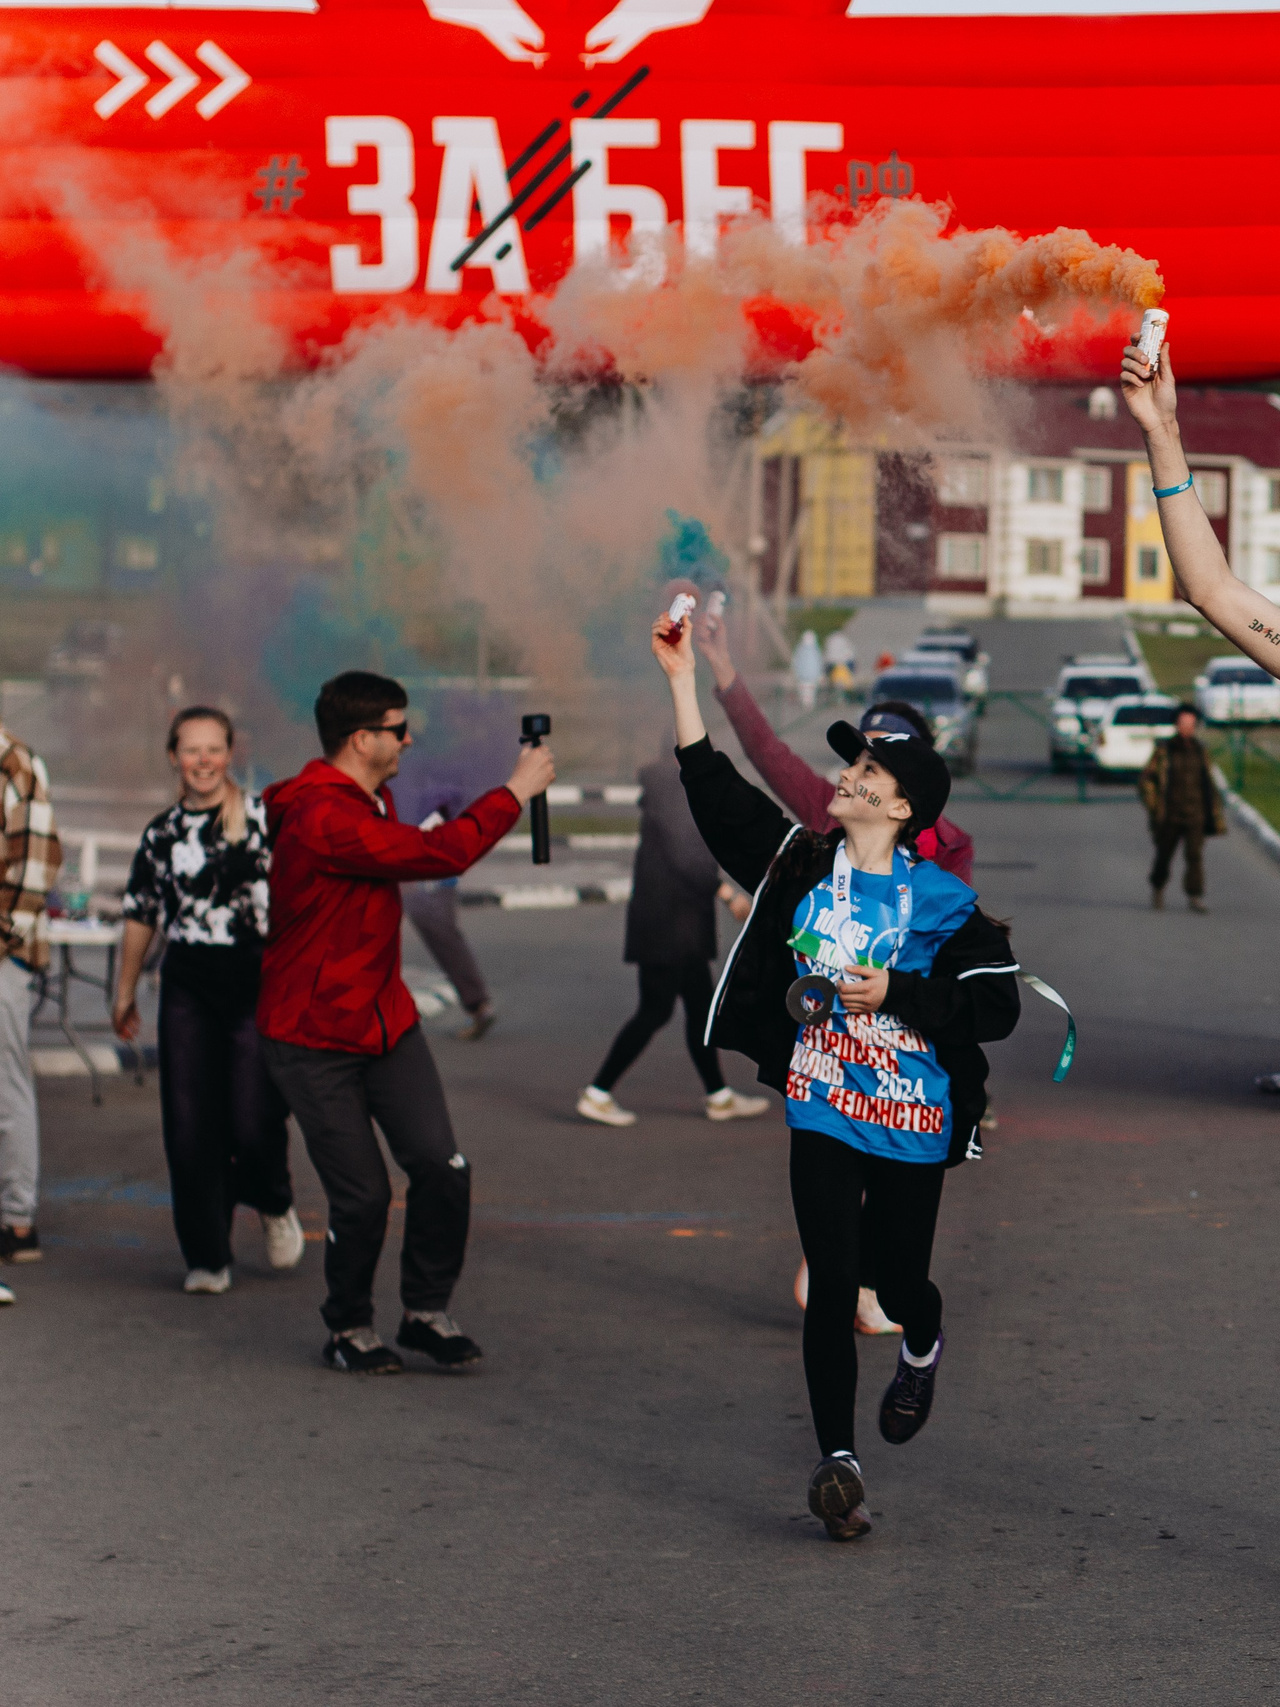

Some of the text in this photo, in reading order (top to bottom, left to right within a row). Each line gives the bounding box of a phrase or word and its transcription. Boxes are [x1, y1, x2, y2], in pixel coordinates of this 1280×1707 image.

[837, 874, 846, 891] ПСБ
[899, 894, 908, 915] ПСБ
[876, 1069, 927, 1104] 2024
[827, 1085, 945, 1135] #ЕДИНСТВО
